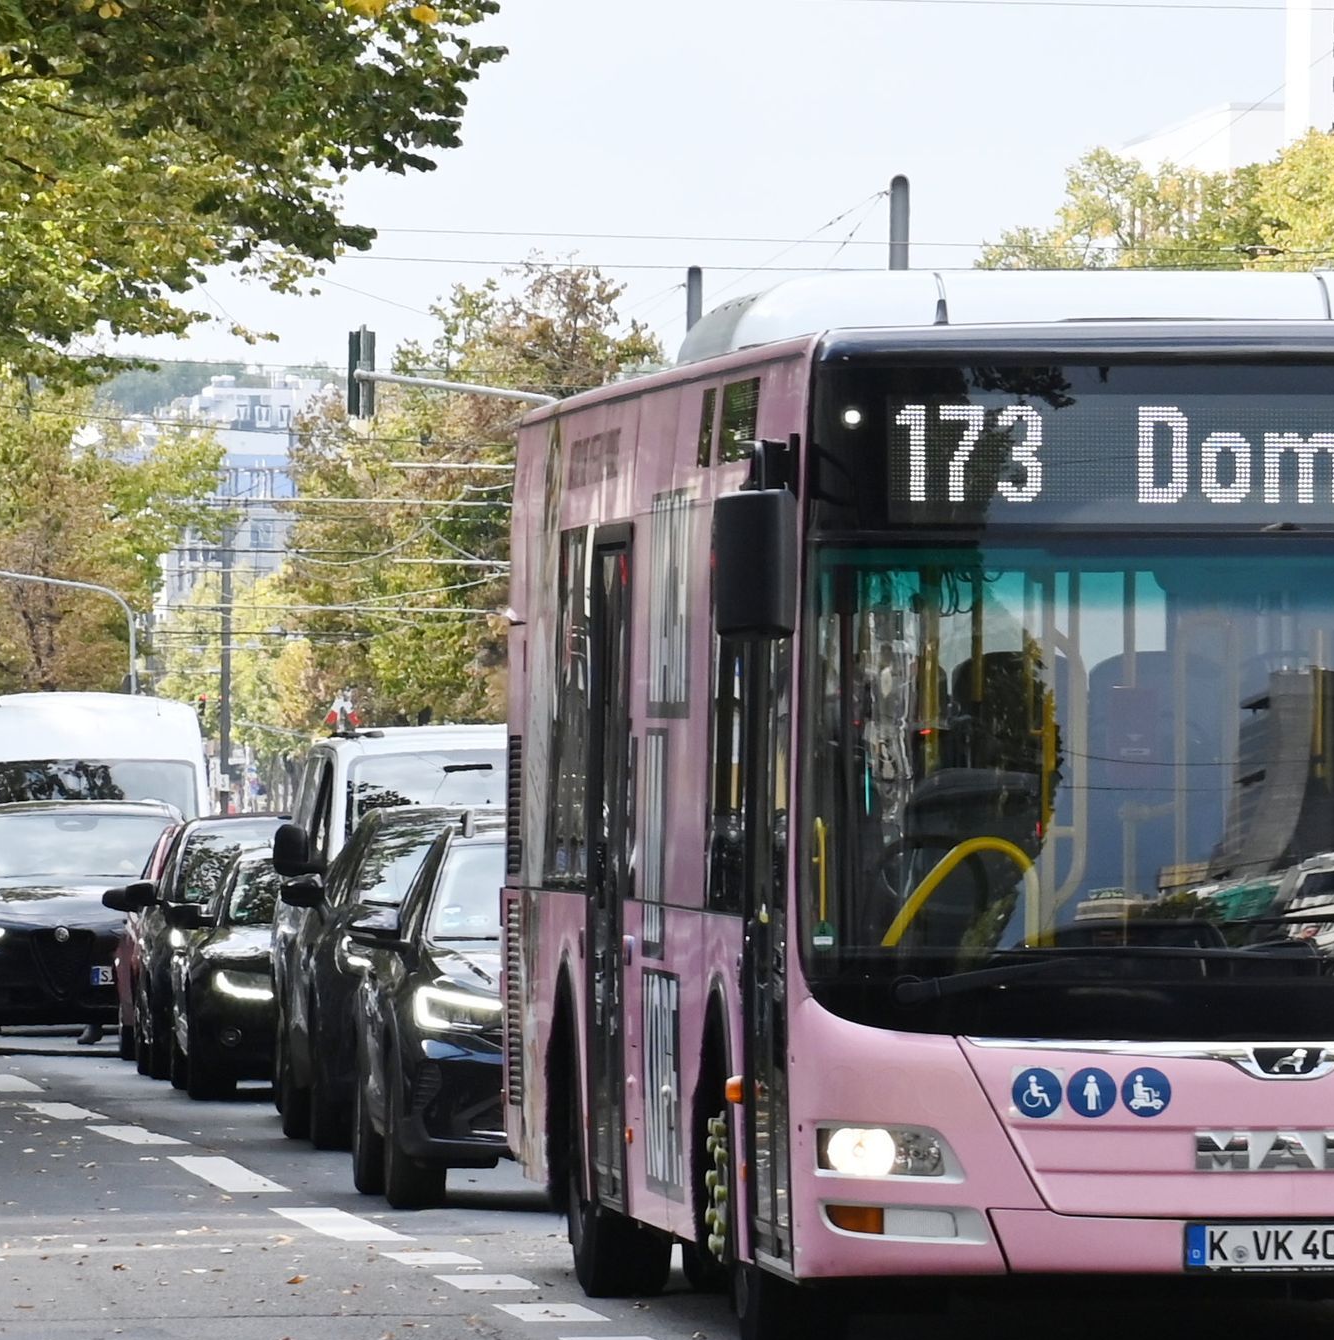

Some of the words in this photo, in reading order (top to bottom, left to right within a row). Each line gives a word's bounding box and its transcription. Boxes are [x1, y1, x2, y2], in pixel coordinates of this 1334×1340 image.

[895, 403, 1043, 502] 173
[1208, 1231, 1229, 1261] K
[1252, 1230, 1294, 1261] VK
